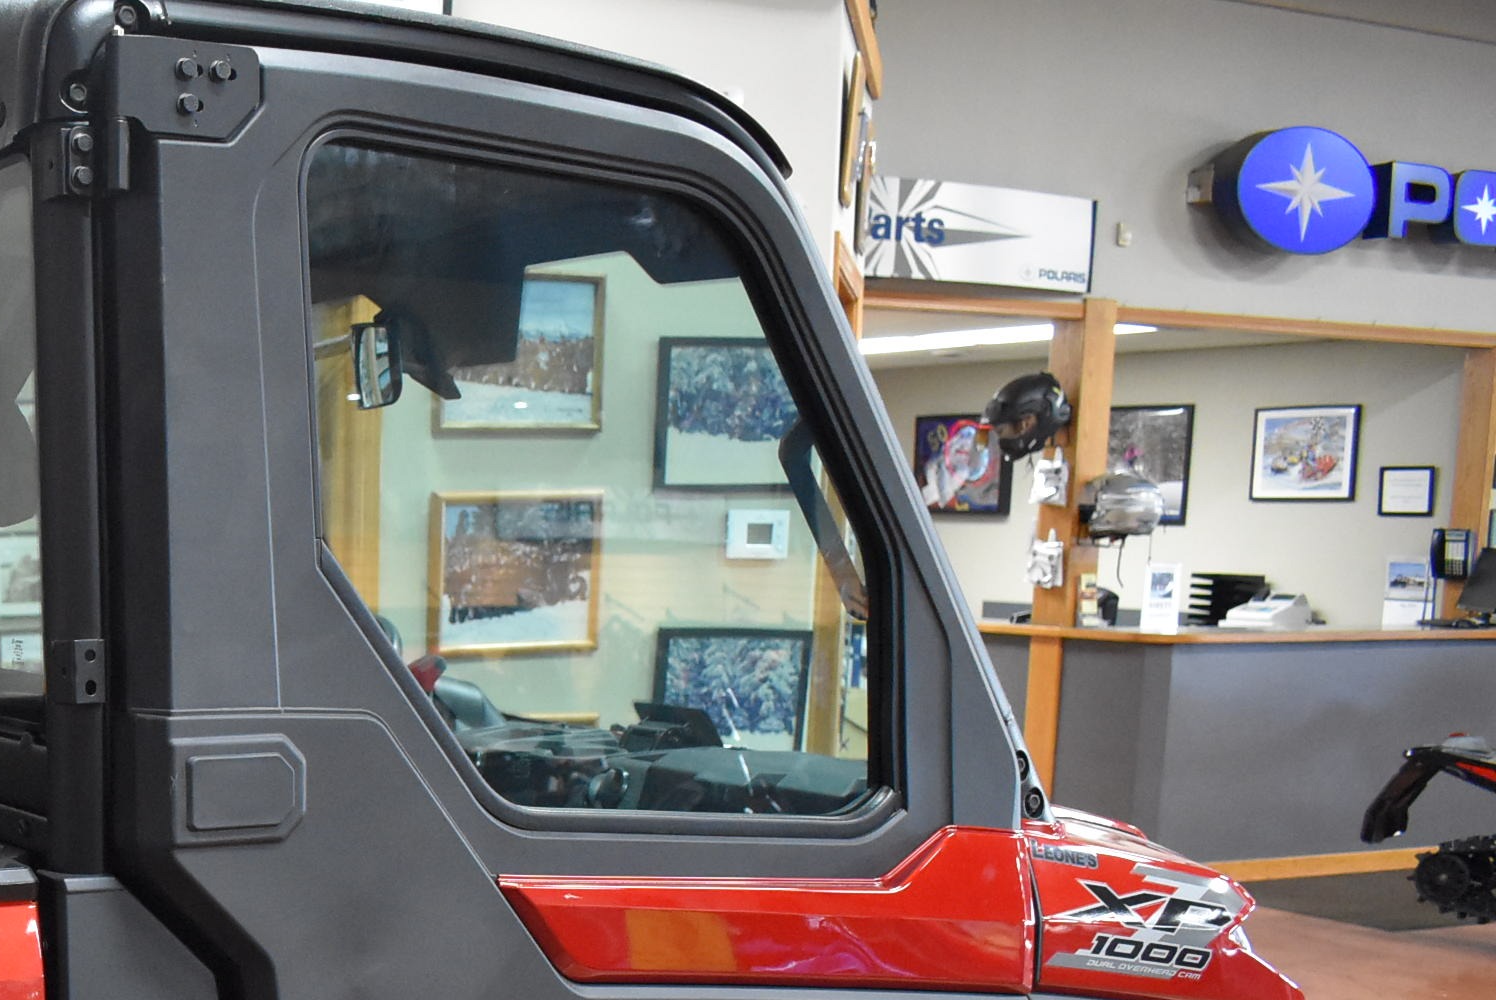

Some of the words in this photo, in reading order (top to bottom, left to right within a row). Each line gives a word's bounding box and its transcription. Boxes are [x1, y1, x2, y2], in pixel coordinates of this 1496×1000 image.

[868, 206, 946, 245] arts
[1038, 268, 1086, 284] POLARIS
[1030, 838, 1099, 869] LEONE'S
[1043, 878, 1236, 934] XP
[1089, 934, 1213, 971] 1000
[1086, 959, 1117, 969] DUAL
[1118, 963, 1178, 977] OVERHEAD
[1177, 971, 1202, 981] CAM
